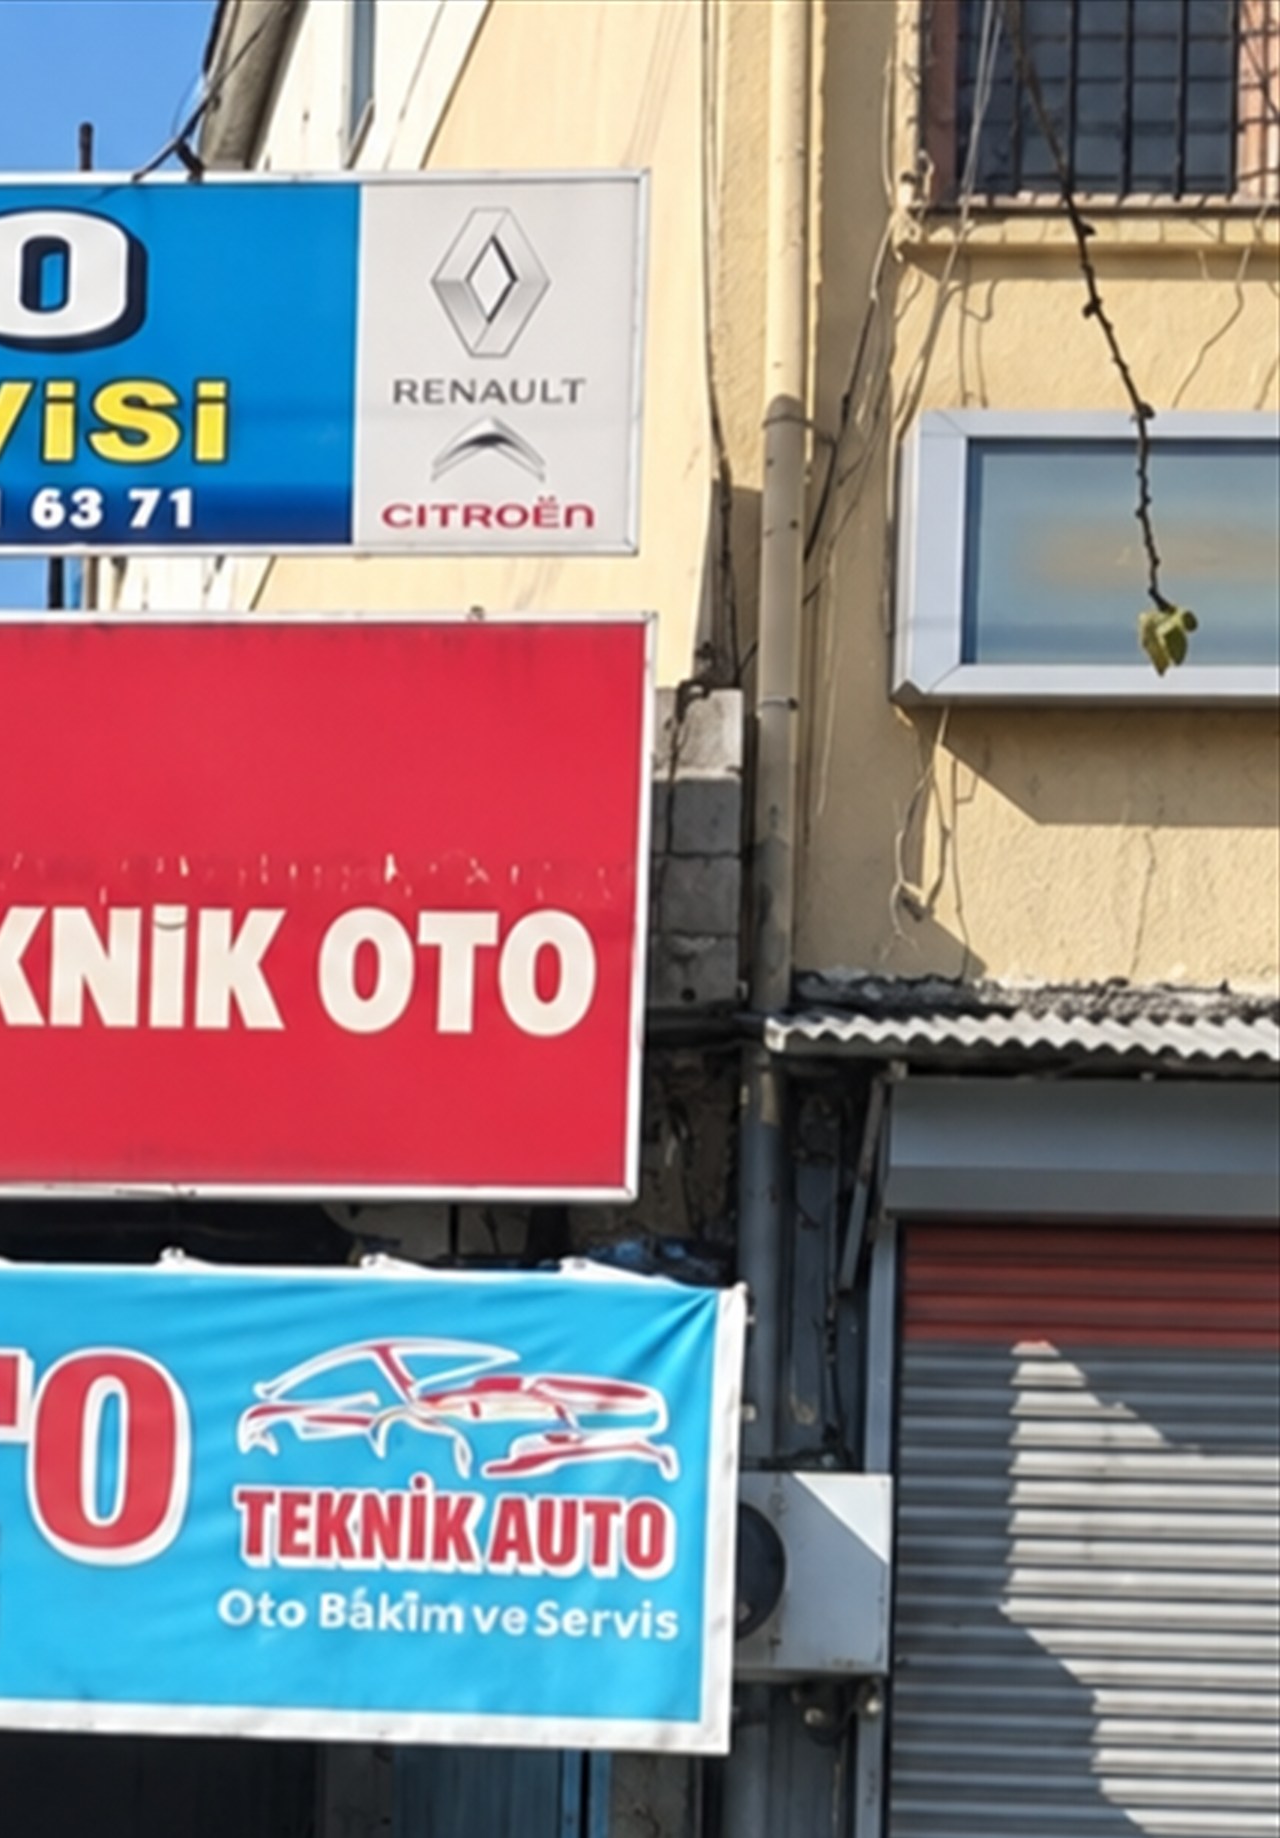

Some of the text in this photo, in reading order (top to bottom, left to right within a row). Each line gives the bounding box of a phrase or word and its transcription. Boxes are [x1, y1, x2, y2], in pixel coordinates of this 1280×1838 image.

[391, 378, 586, 405] RENAULT
[30, 487, 104, 530] 63
[128, 487, 193, 529] 71
[317, 906, 598, 1037] OTO
[236, 1475, 670, 1572] TEKNİK AUTO
[217, 1588, 308, 1629] Oto
[472, 1603, 528, 1636] ve
[534, 1599, 680, 1641] Servis
